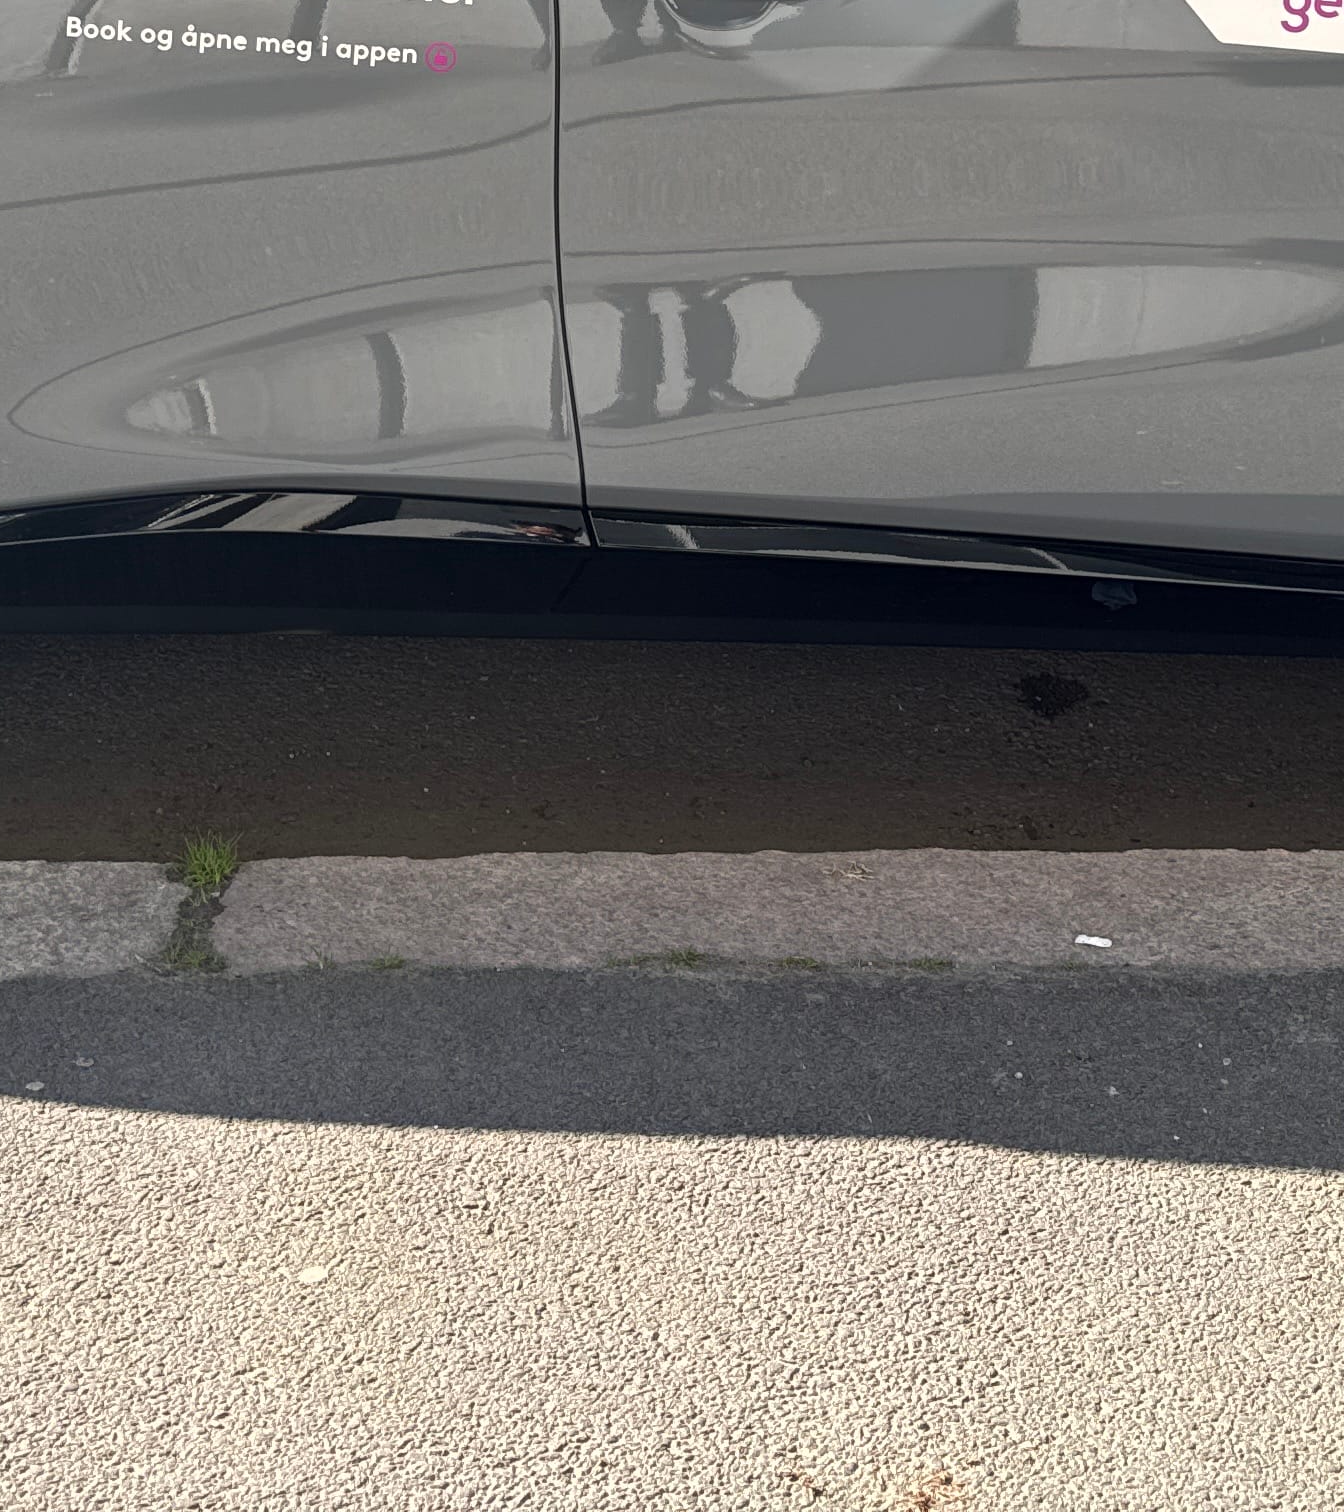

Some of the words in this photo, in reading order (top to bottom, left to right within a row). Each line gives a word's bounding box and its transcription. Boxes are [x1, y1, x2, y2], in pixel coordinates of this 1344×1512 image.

[66, 16, 132, 42] Book
[140, 27, 173, 51] og
[181, 24, 248, 54] åpne
[255, 36, 313, 62] meg
[321, 35, 329, 57] i
[335, 43, 418, 67] appen
